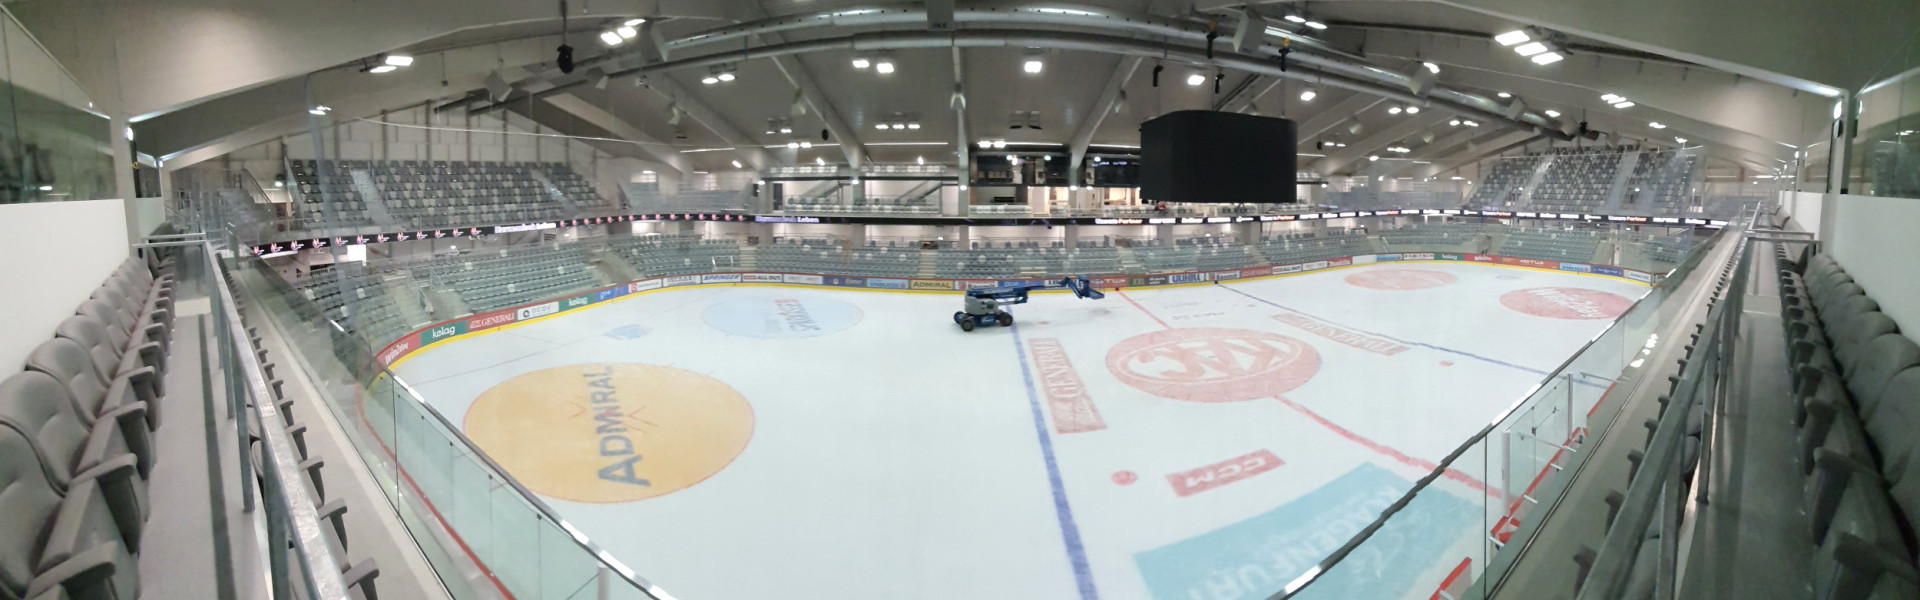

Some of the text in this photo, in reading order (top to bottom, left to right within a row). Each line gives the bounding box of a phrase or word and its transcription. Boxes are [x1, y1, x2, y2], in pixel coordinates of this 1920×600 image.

[433, 326, 456, 340] kelag
[482, 313, 515, 328] GENERALI
[1033, 341, 1082, 398] GENERALI
[582, 365, 651, 487] ADMIRAL
[1186, 457, 1267, 488] CCM
